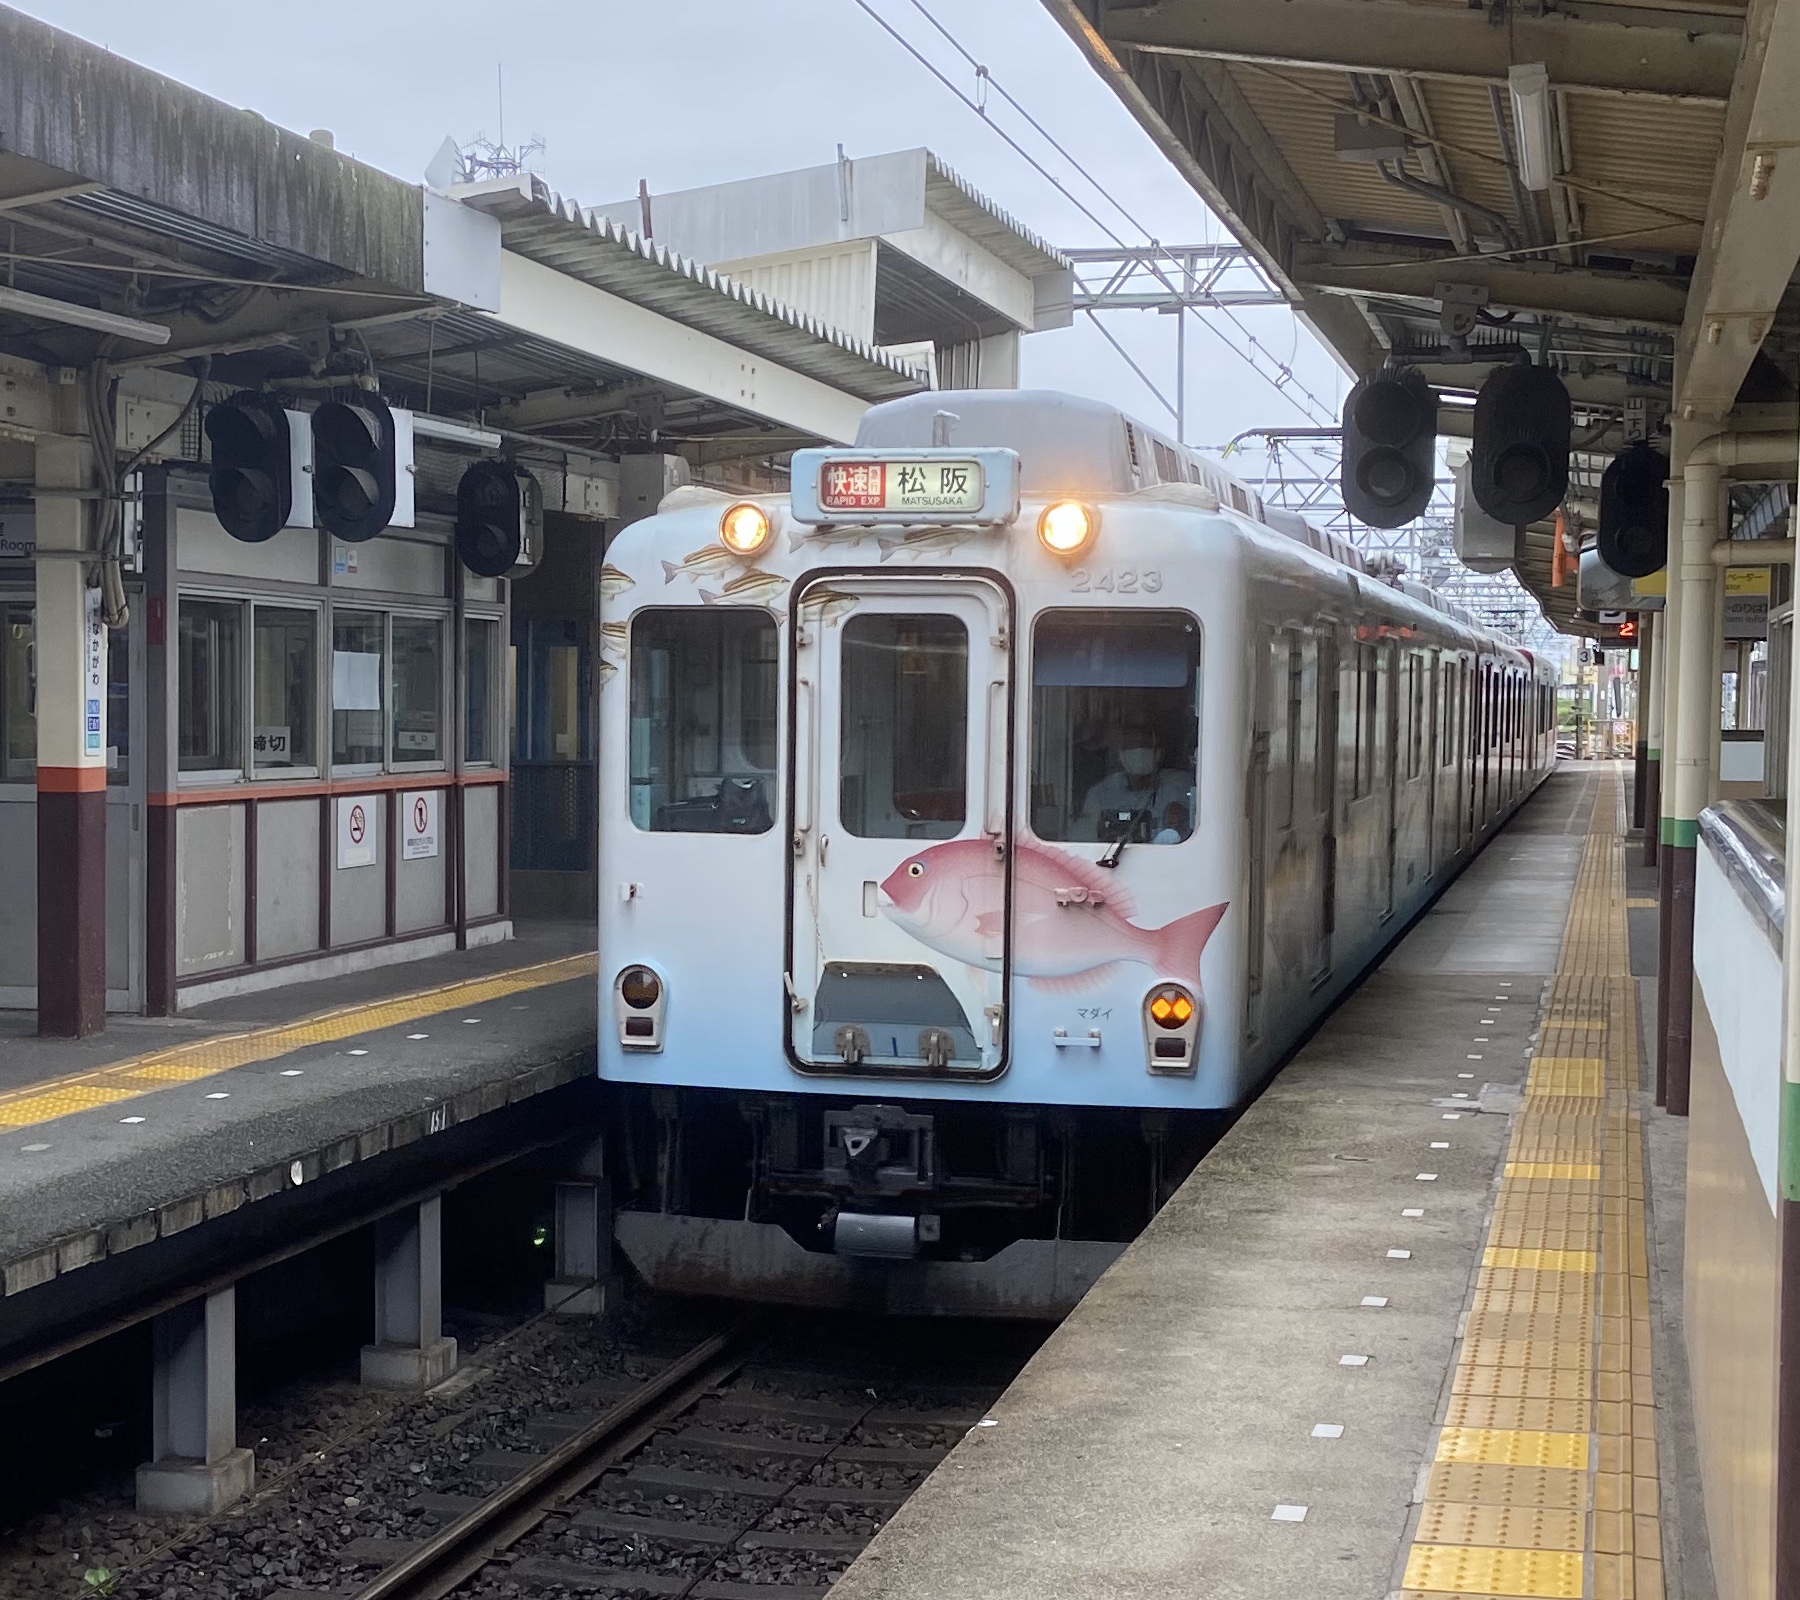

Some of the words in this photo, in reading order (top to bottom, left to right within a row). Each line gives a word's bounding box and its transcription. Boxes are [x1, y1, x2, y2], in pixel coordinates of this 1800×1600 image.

[828, 465, 868, 496] 快速
[897, 466, 969, 495] 松阪
[826, 496, 855, 506] RAPID
[901, 496, 964, 506] MATSUSAKA
[1, 539, 37, 551] Room
[1070, 567, 1163, 594] 2423
[1620, 622, 1635, 637] 2
[1580, 651, 1589, 663] 3
[1077, 1007, 1113, 1020] マダイ
